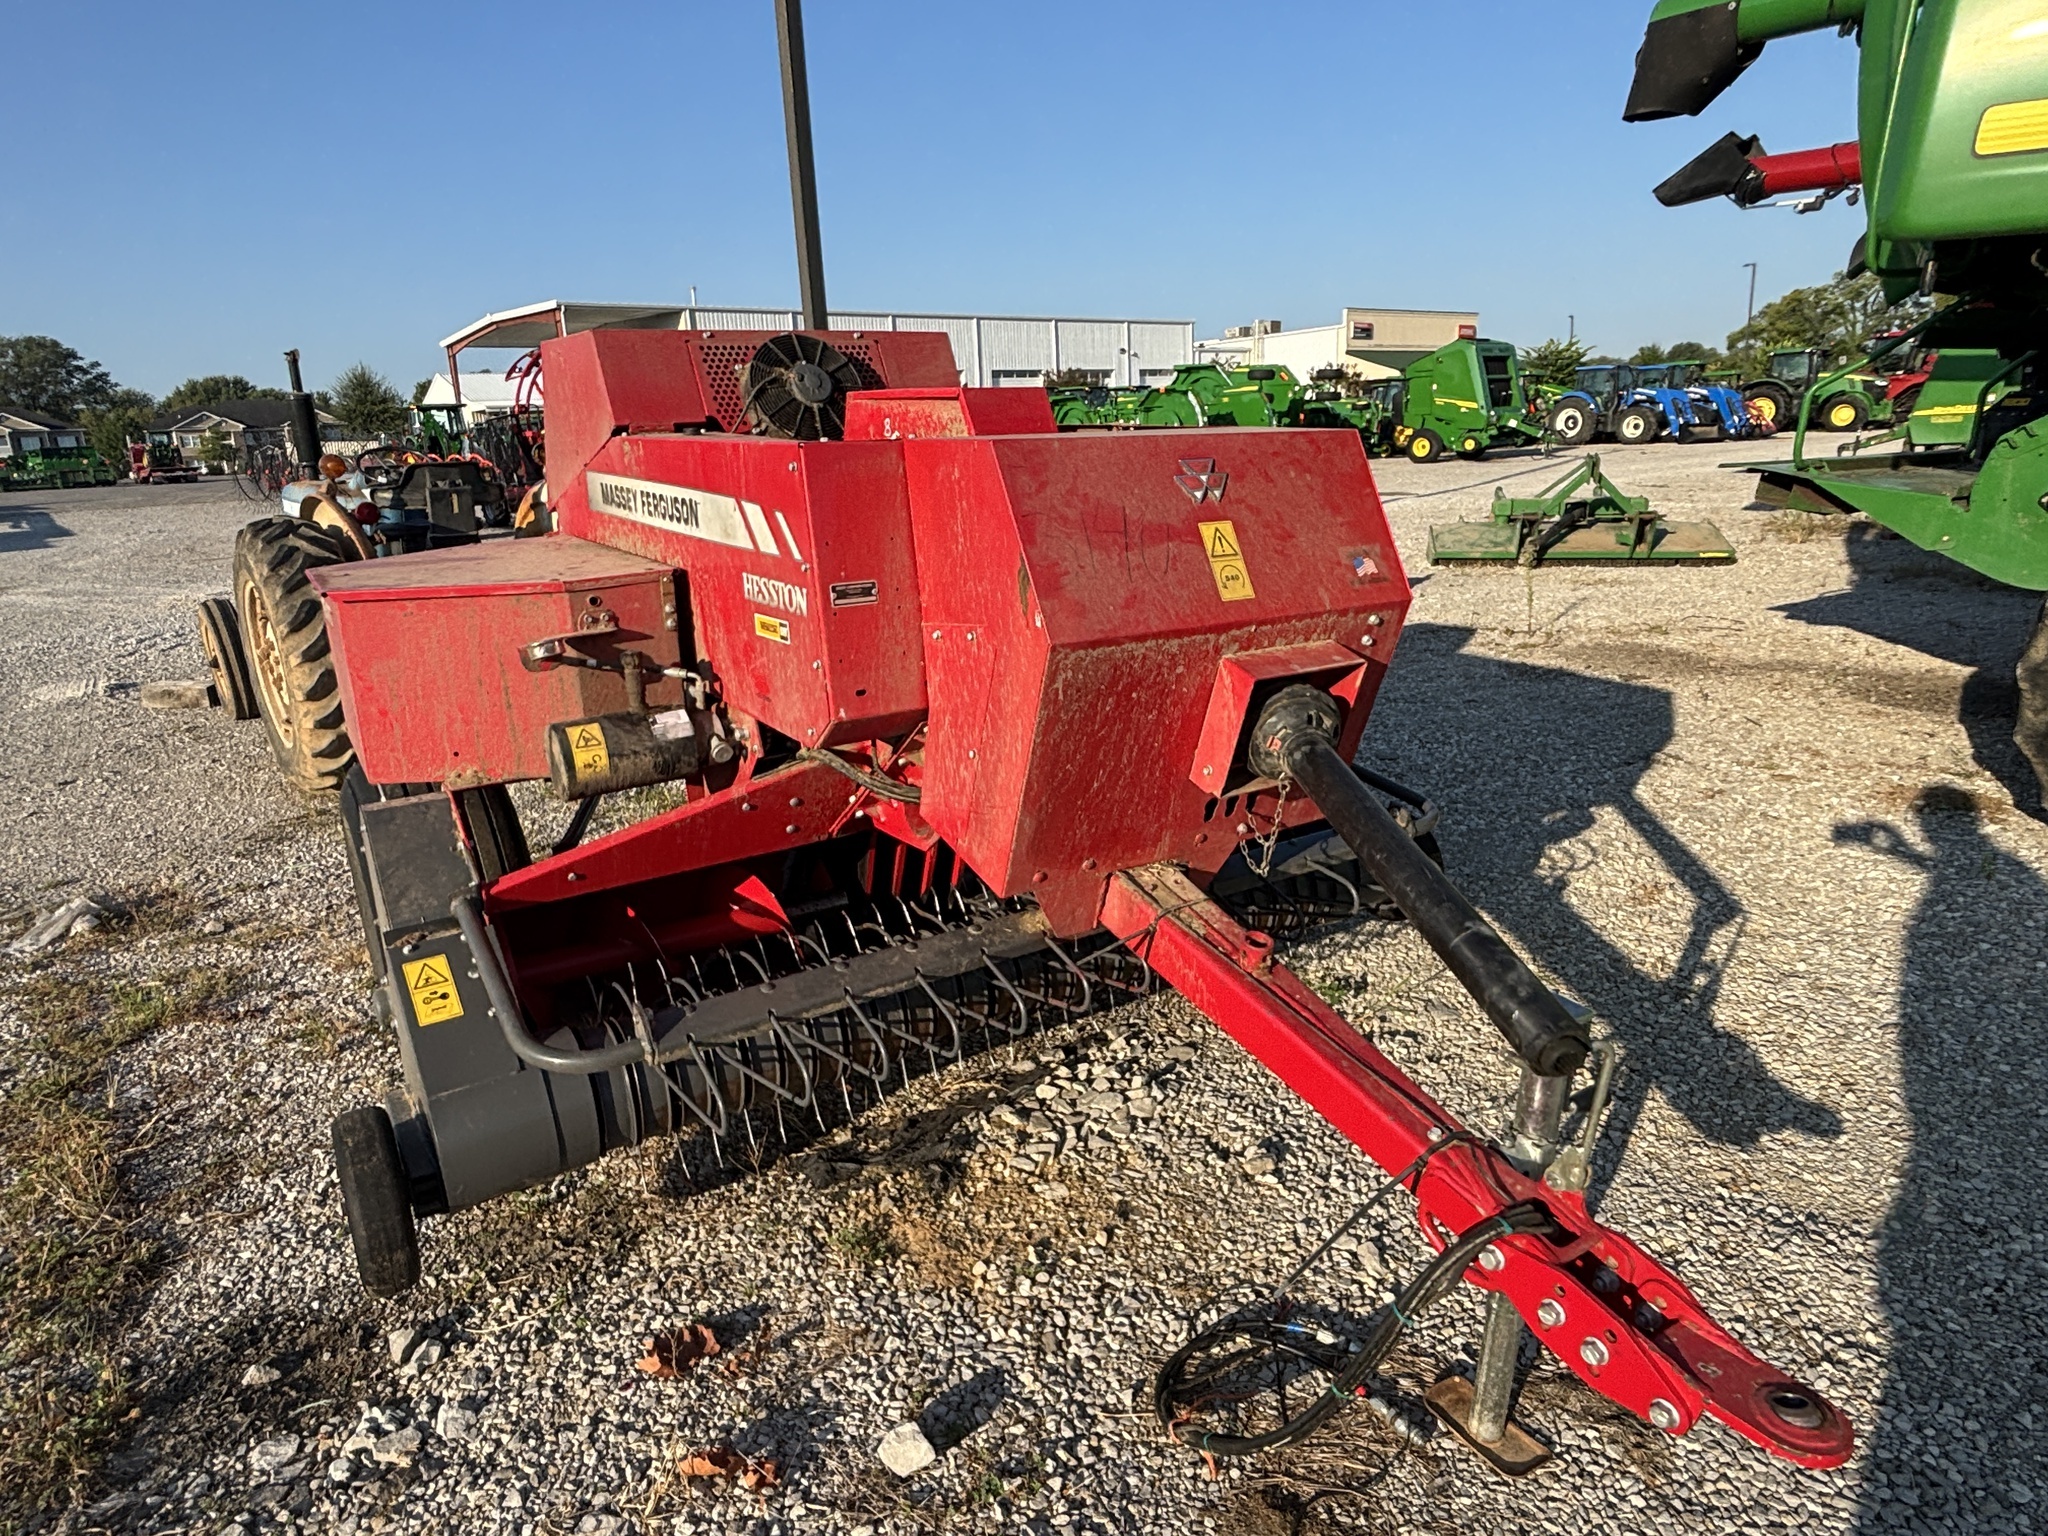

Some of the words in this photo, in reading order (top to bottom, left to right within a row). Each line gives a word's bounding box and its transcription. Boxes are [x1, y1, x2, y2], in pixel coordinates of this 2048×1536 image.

[600, 482, 638, 513] MASSEY
[640, 489, 699, 529] FERGUSON
[742, 572, 807, 617] HESSTON
